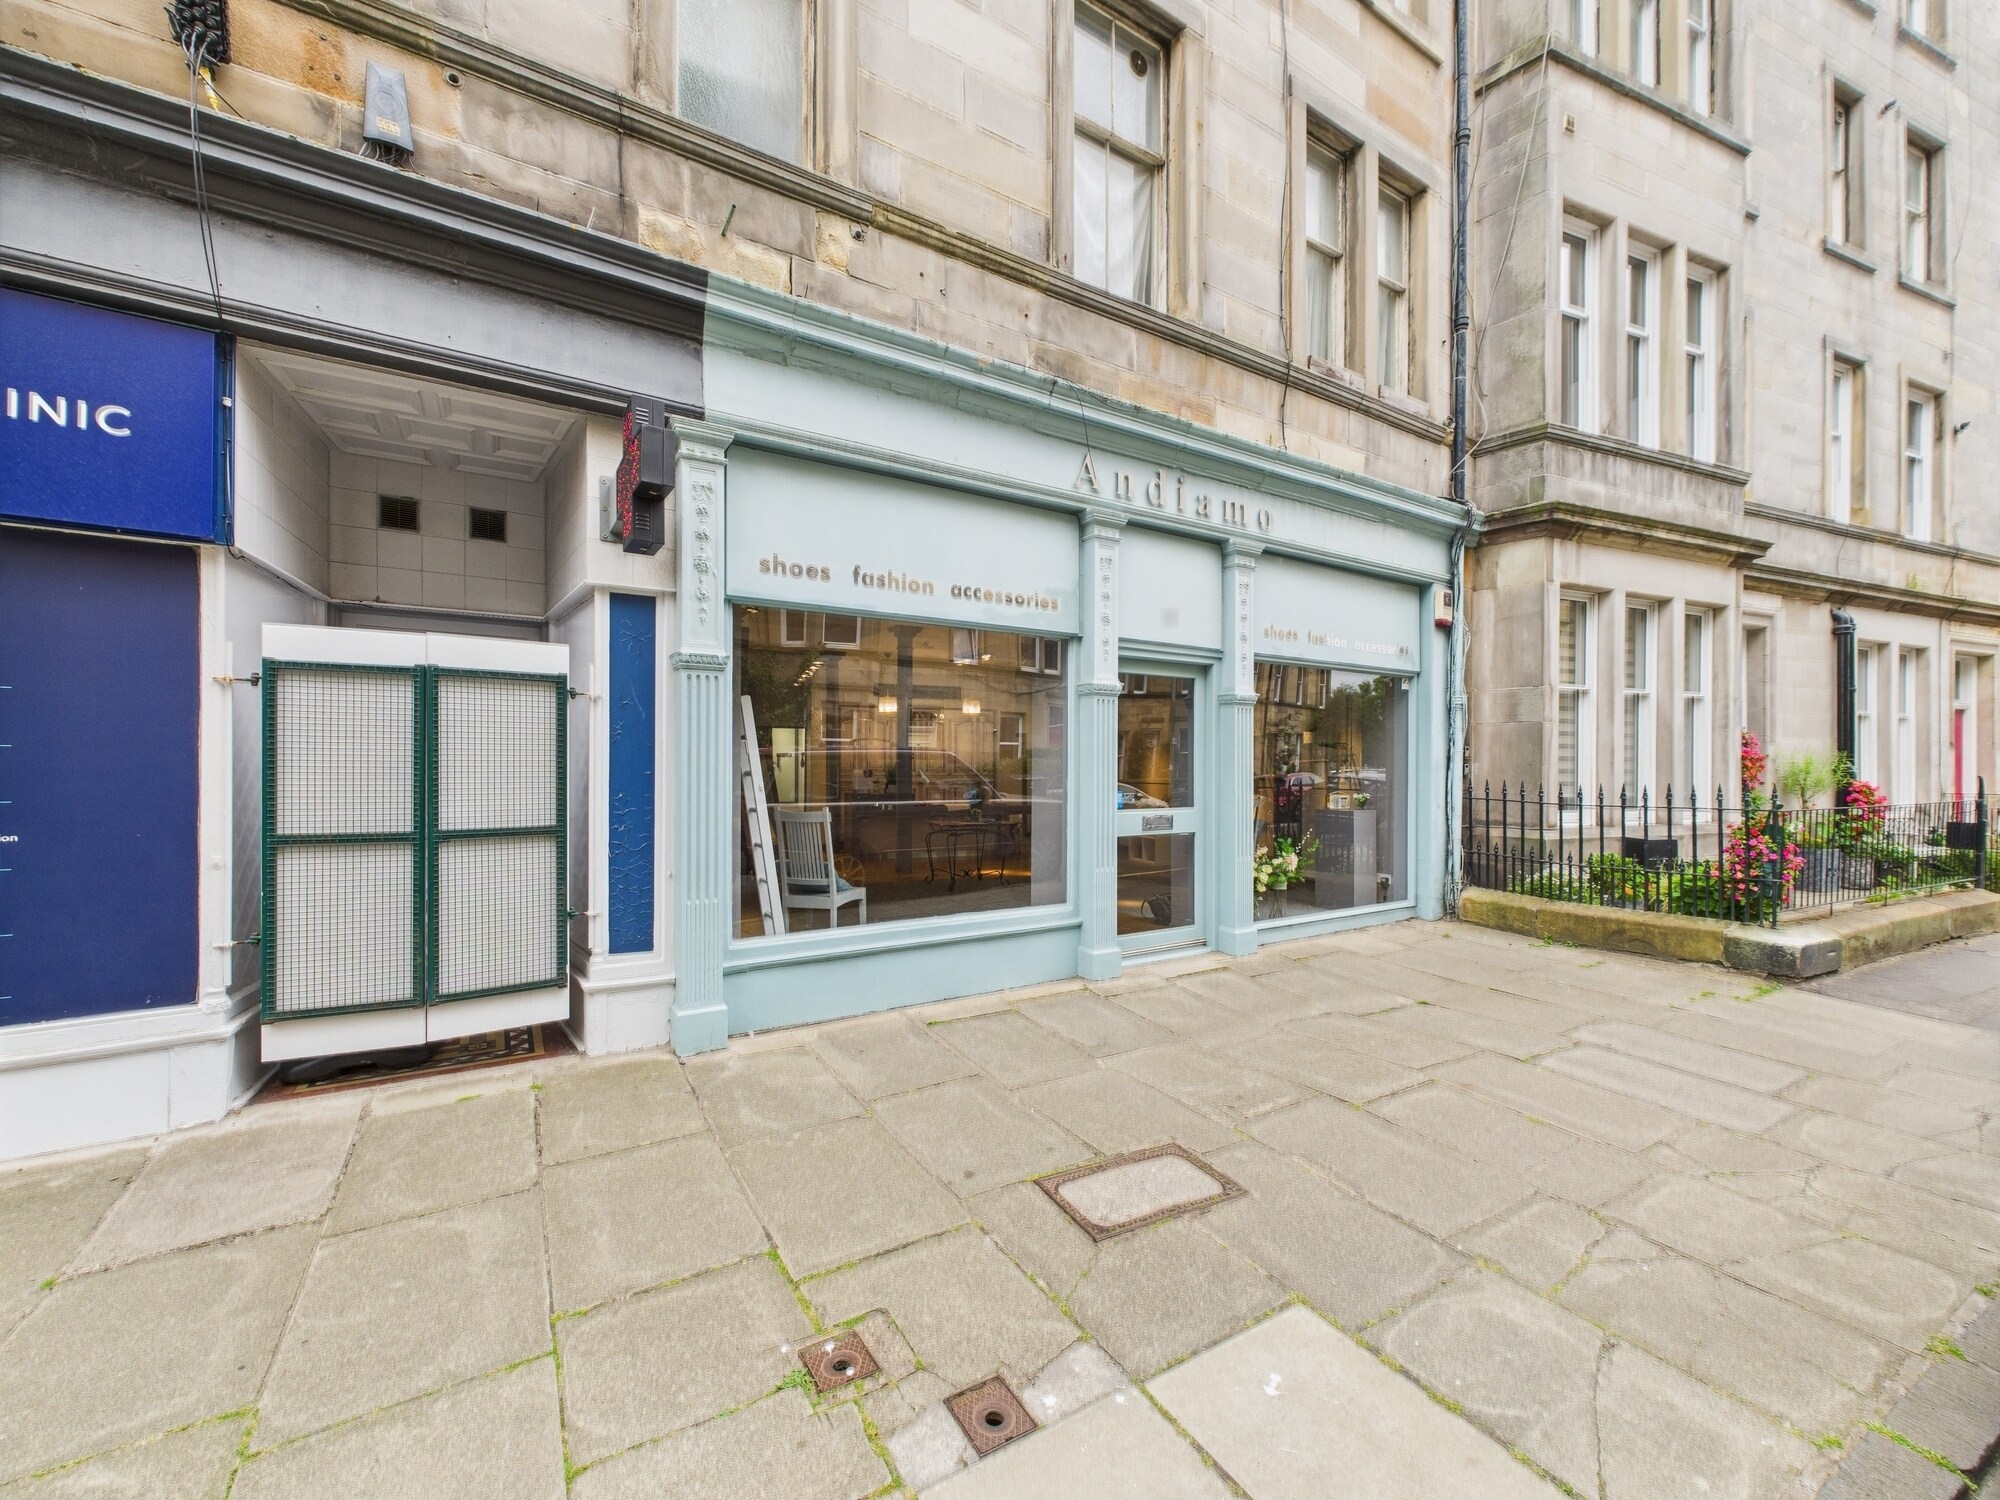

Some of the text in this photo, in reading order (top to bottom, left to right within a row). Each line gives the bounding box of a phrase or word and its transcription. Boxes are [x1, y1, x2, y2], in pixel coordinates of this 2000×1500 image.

[6, 386, 132, 437] INIC
[1074, 451, 1272, 532] Andiamo
[758, 551, 1059, 611] shoes fashion accessories
[1263, 623, 1299, 641] shoes
